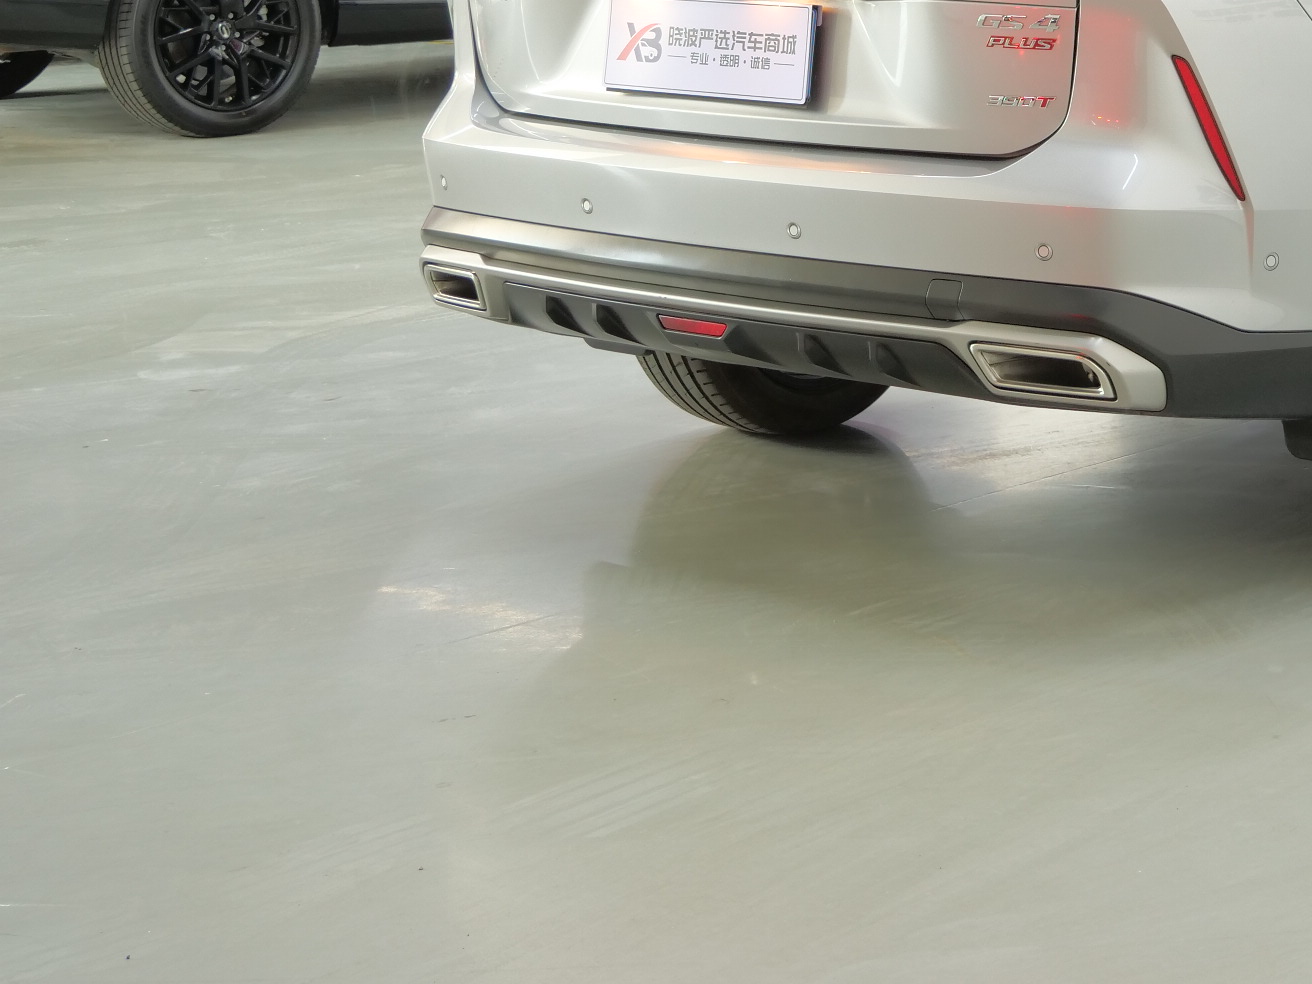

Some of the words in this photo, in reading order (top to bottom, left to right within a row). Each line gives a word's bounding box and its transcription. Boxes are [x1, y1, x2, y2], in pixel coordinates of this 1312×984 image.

[668, 26, 798, 56] 晓波严选汽车商城
[986, 35, 1057, 51] PLUS
[986, 95, 1055, 108] 390T
